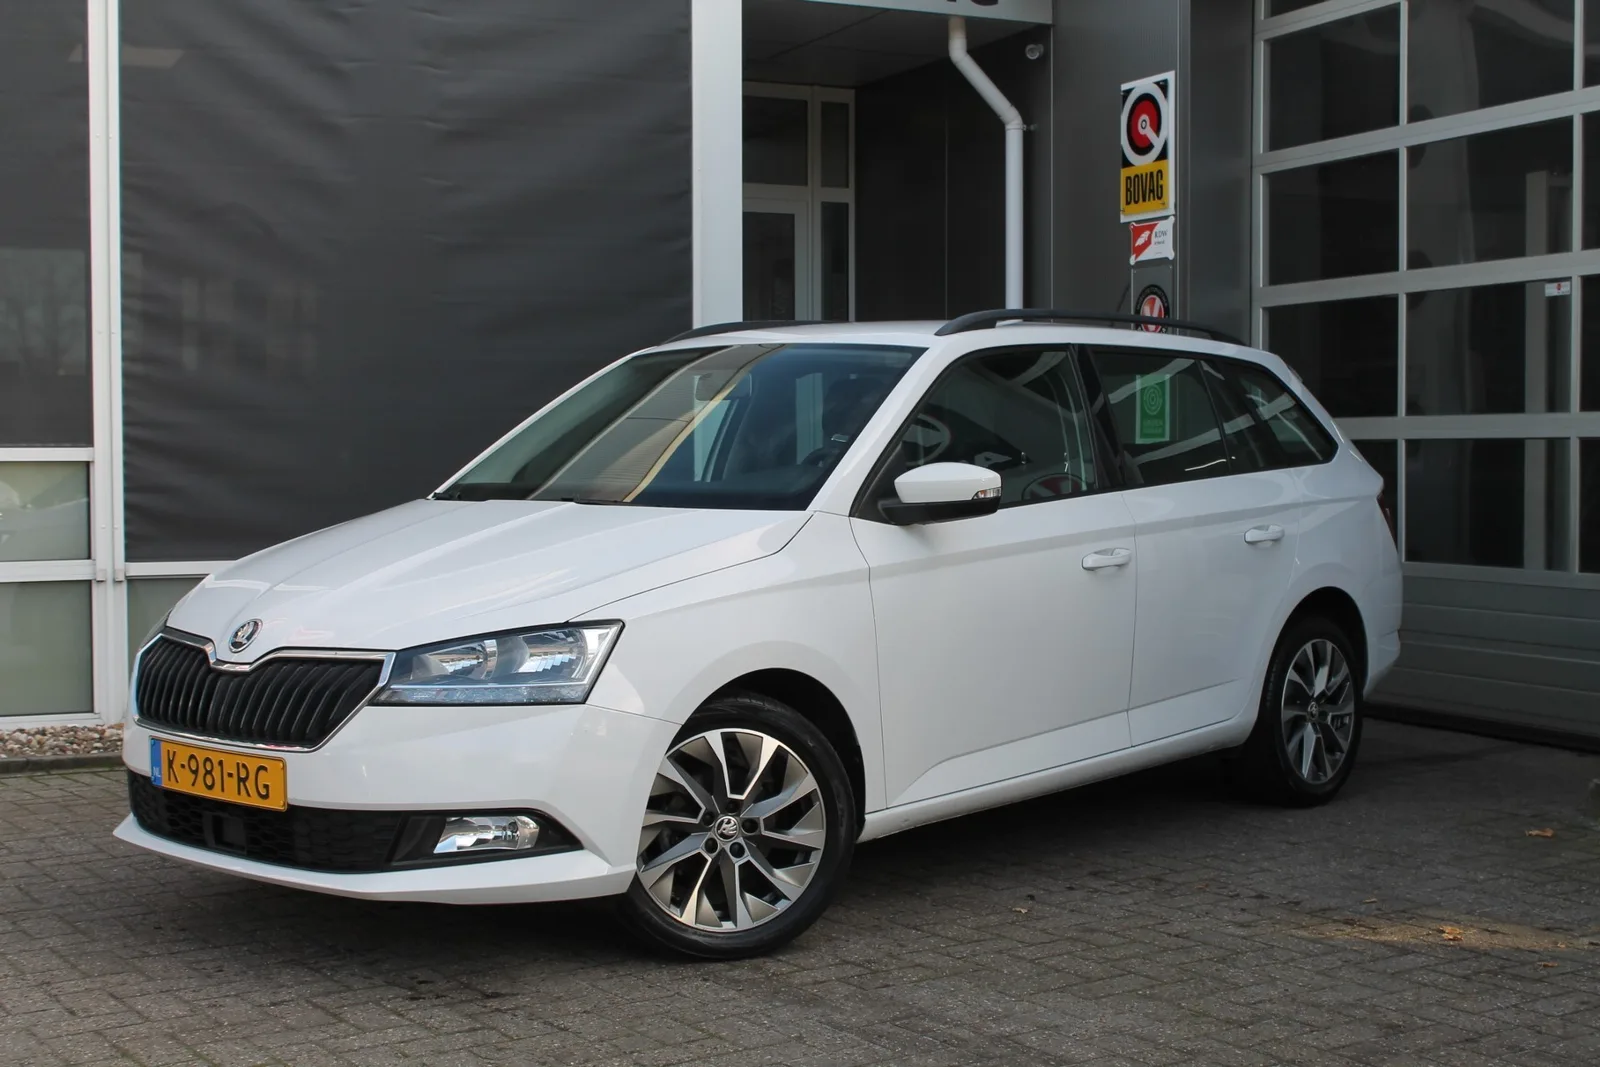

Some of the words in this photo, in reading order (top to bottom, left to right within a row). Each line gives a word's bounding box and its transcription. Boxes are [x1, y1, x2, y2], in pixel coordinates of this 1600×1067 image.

[1125, 169, 1163, 206] BOVAG
[153, 766, 161, 777] NL
[167, 749, 270, 800] K-981-RG
